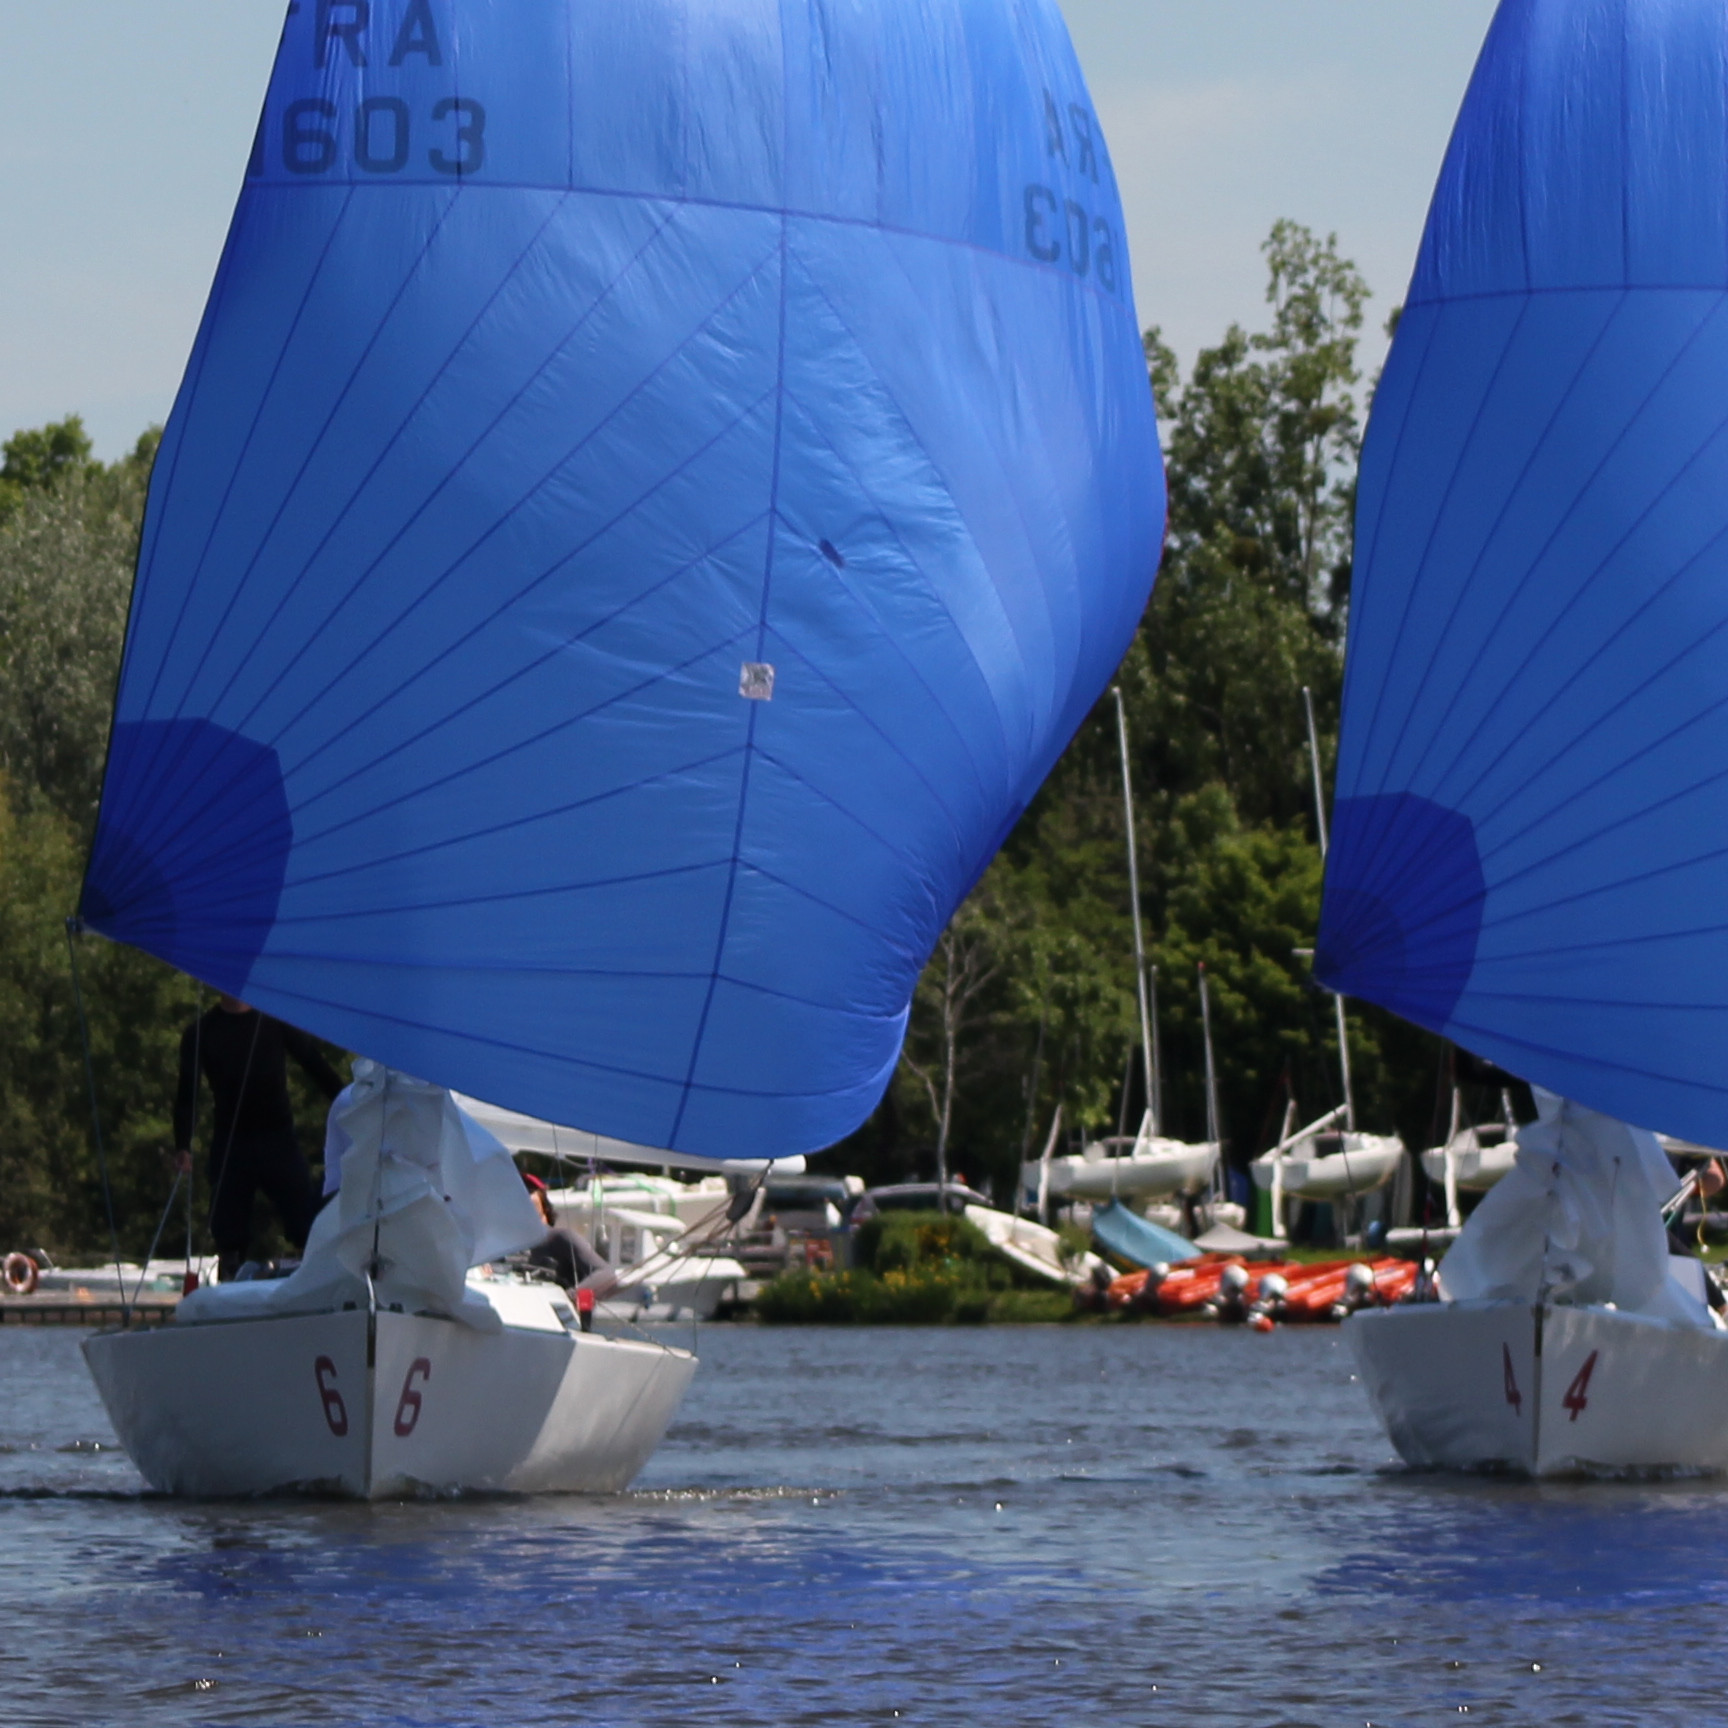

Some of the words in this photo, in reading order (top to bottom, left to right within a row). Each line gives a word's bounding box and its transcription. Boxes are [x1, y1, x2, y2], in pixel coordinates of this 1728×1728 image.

[315, 1355, 348, 1437] 6
[394, 1357, 430, 1437] 6
[1562, 1349, 1598, 1422] 4
